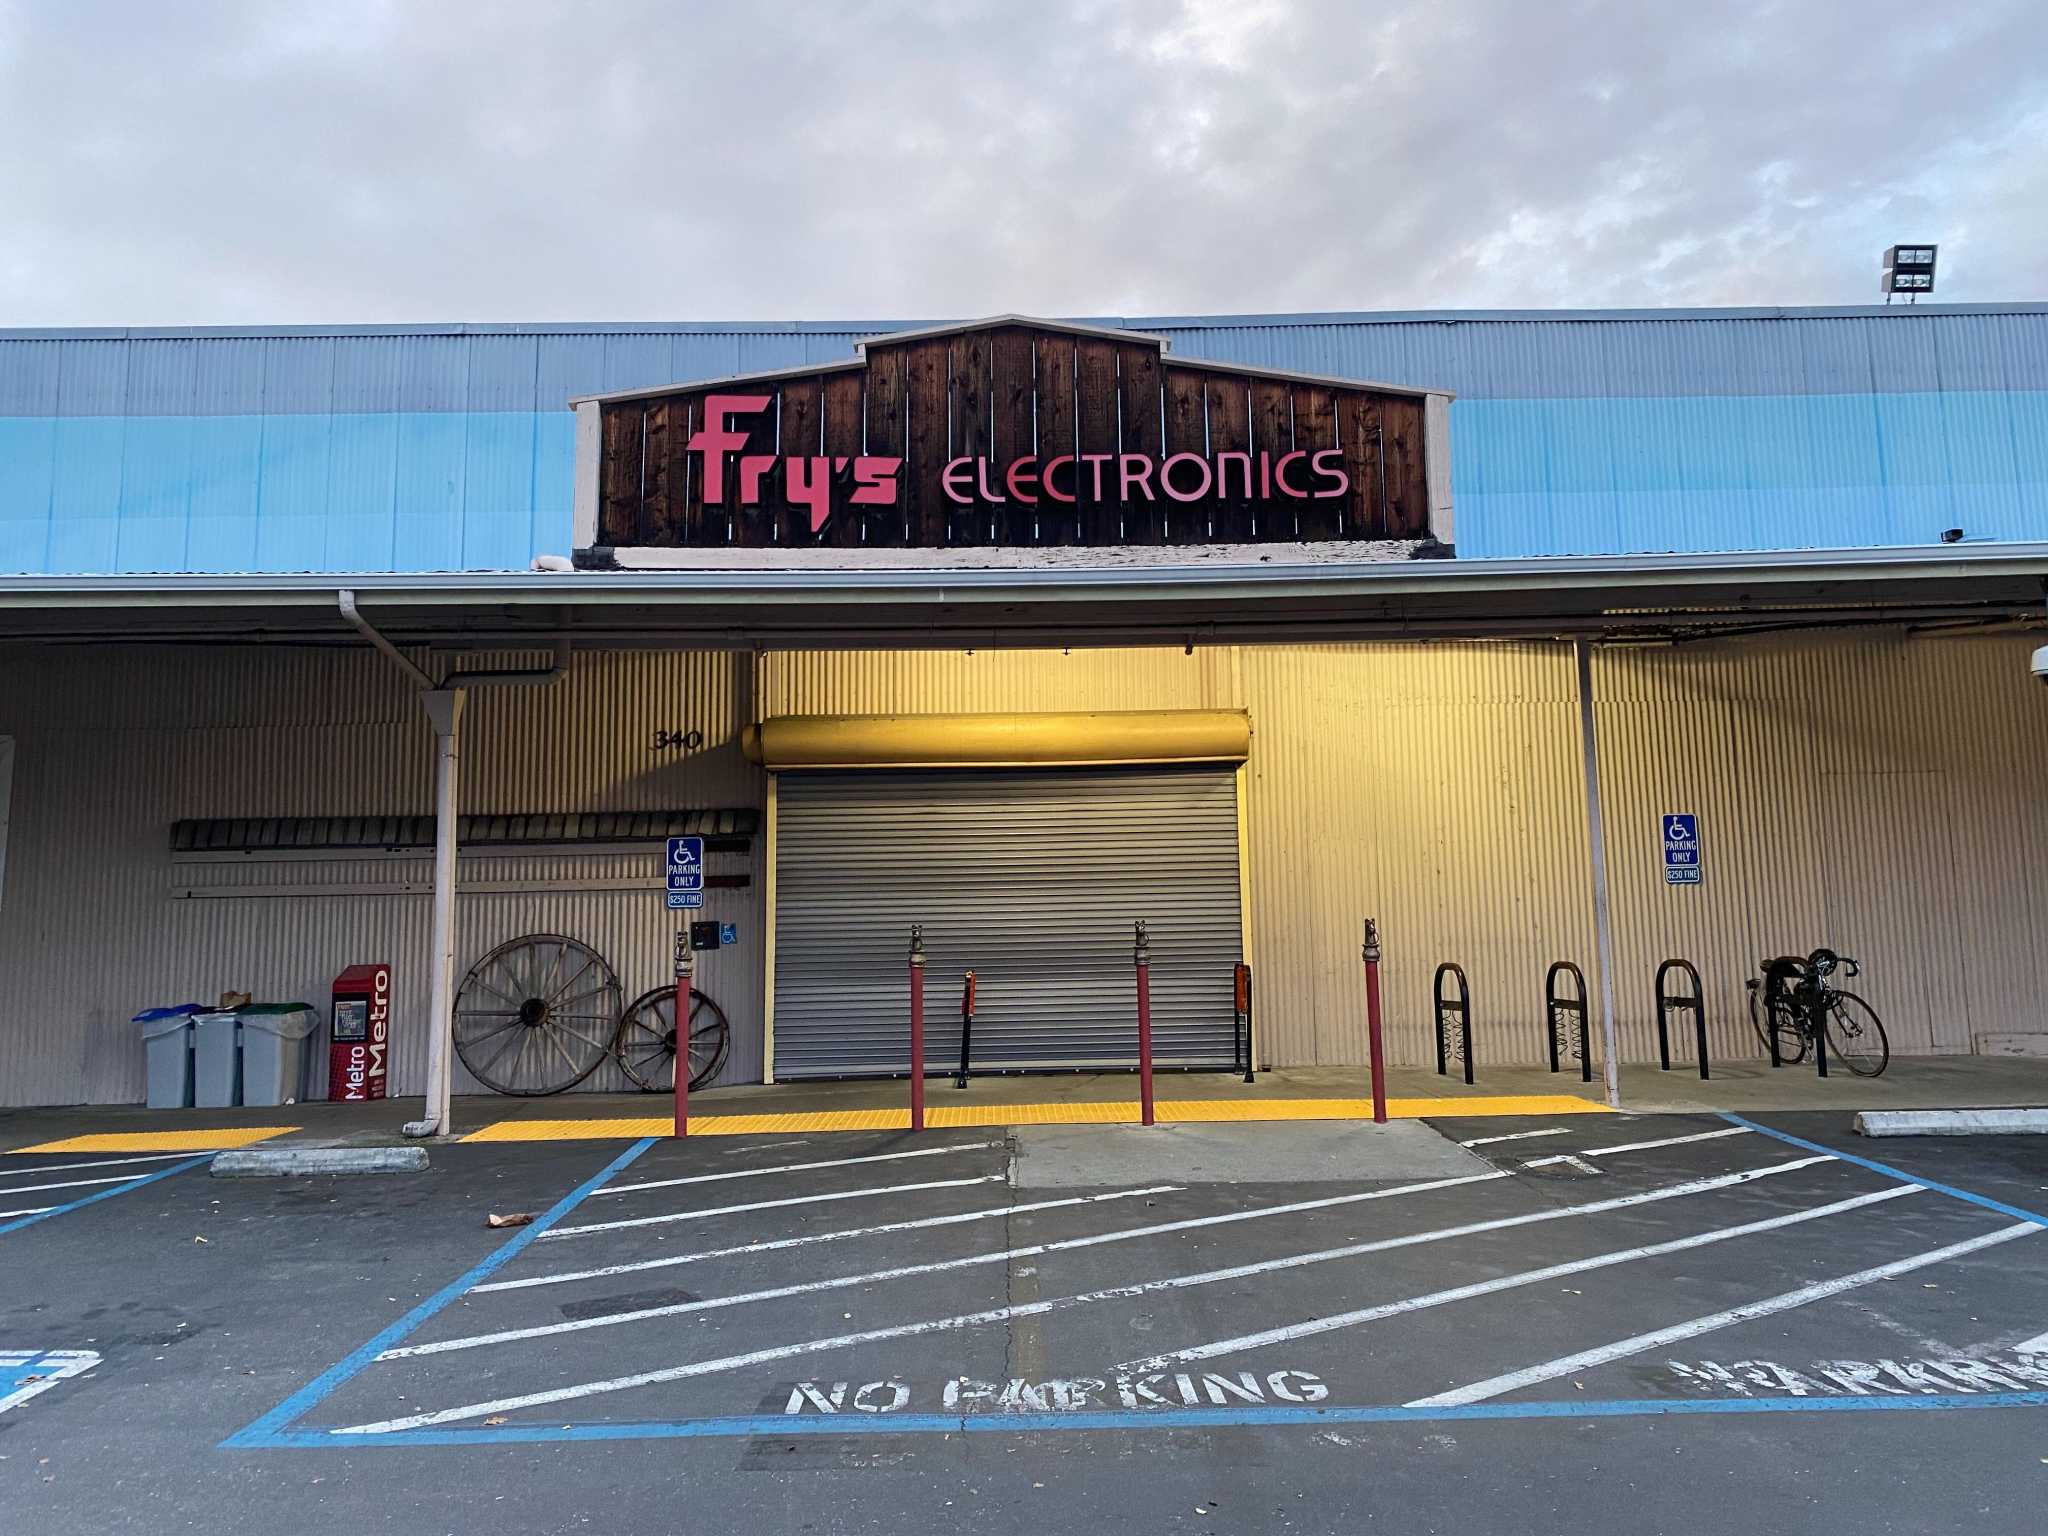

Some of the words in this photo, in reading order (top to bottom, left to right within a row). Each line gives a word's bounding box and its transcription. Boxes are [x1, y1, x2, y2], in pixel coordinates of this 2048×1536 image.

[686, 394, 904, 534] Fry's
[941, 448, 1350, 504] ELECTRONICS
[650, 729, 703, 750] 340
[1665, 840, 1696, 850] PARKING
[1672, 852, 1690, 862] ONLY
[668, 864, 700, 875] PARKING
[1667, 870, 1683, 879] $250
[1684, 870, 1697, 878] FINE
[674, 876, 695, 887] ONLY
[670, 894, 686, 904] $250
[686, 894, 701, 904] FINE
[368, 970, 388, 1077] Metro
[345, 1046, 365, 1100] Metro
[784, 1379, 910, 1415] NO
